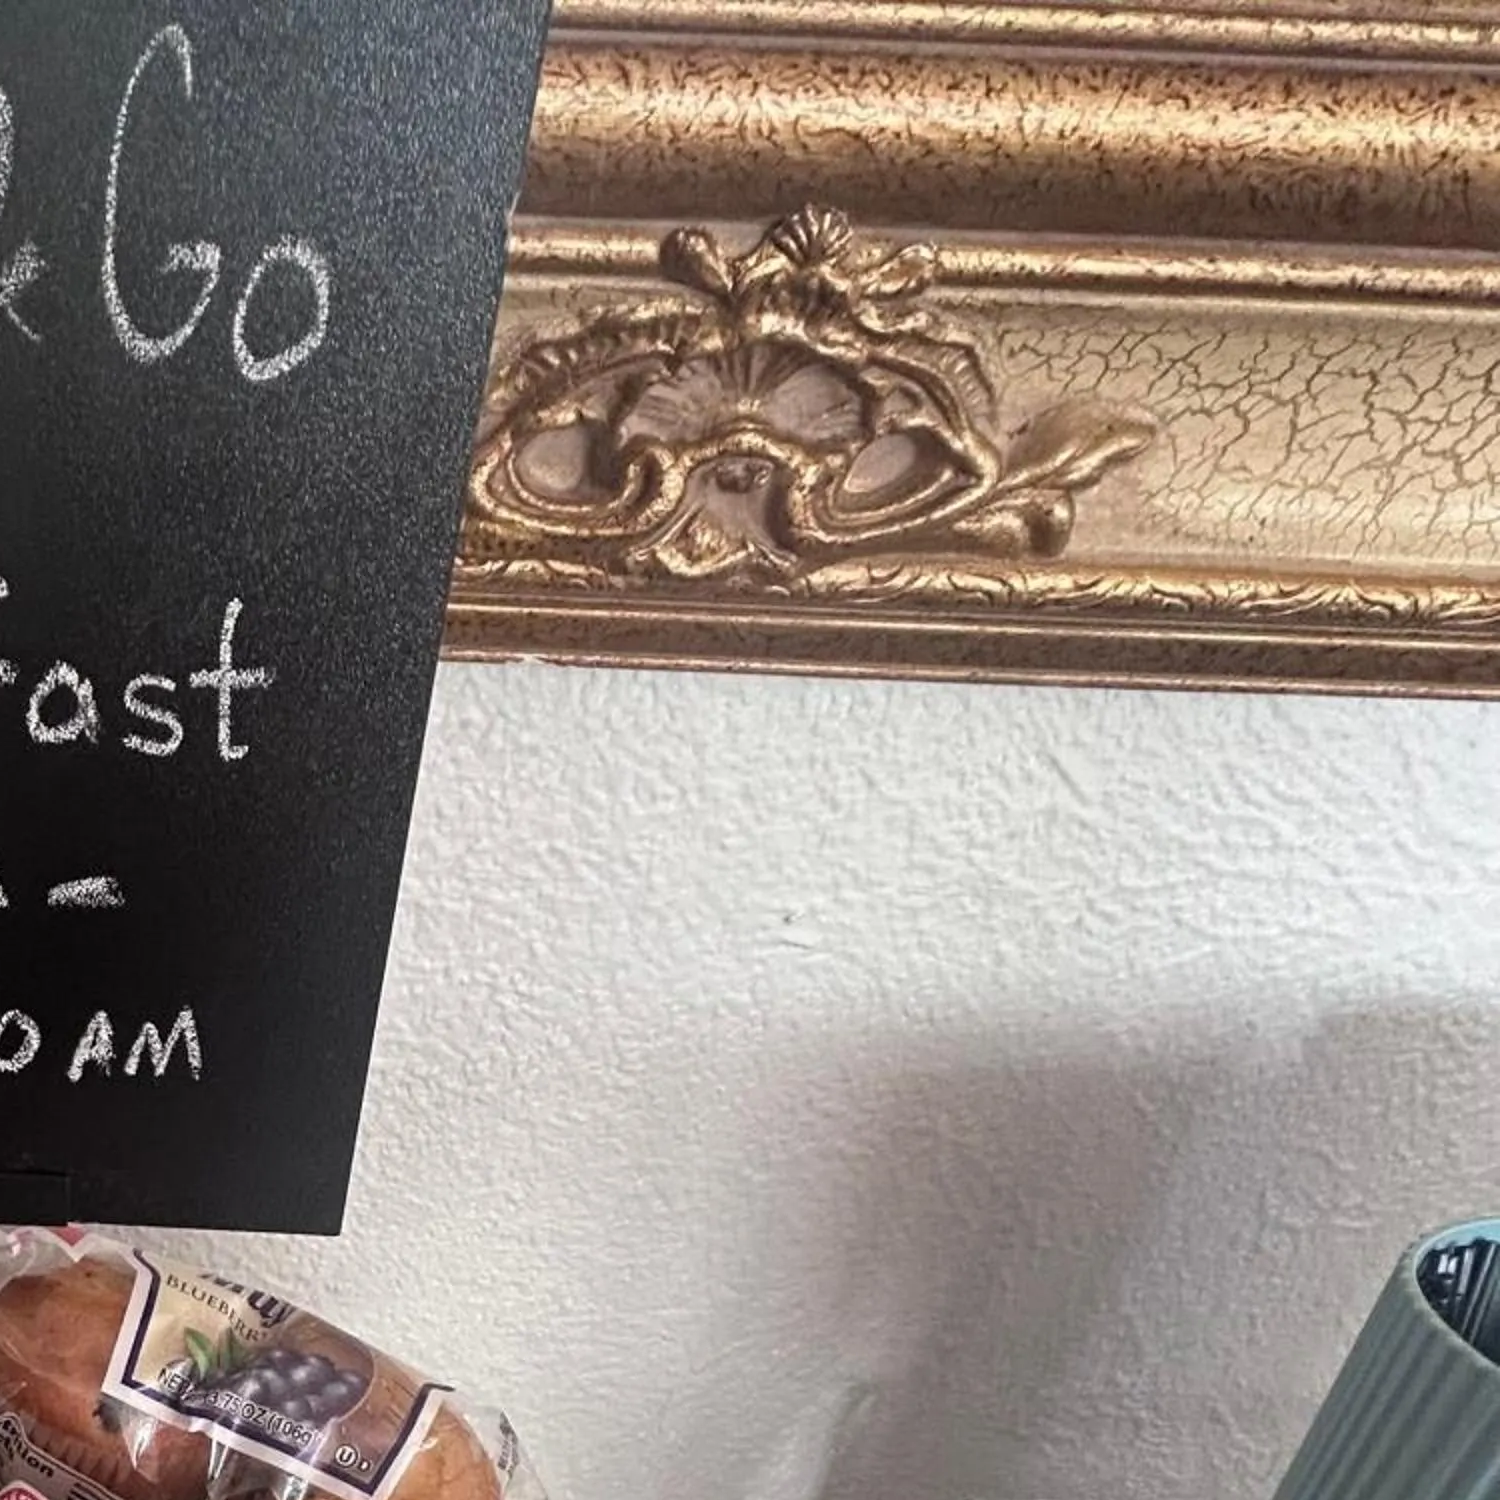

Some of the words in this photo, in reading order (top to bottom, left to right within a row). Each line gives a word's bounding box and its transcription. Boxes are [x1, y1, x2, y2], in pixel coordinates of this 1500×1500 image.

[101, 25, 332, 382] Go
[67, 1005, 204, 1083] AM
[241, 1402, 267, 1424] OZ
